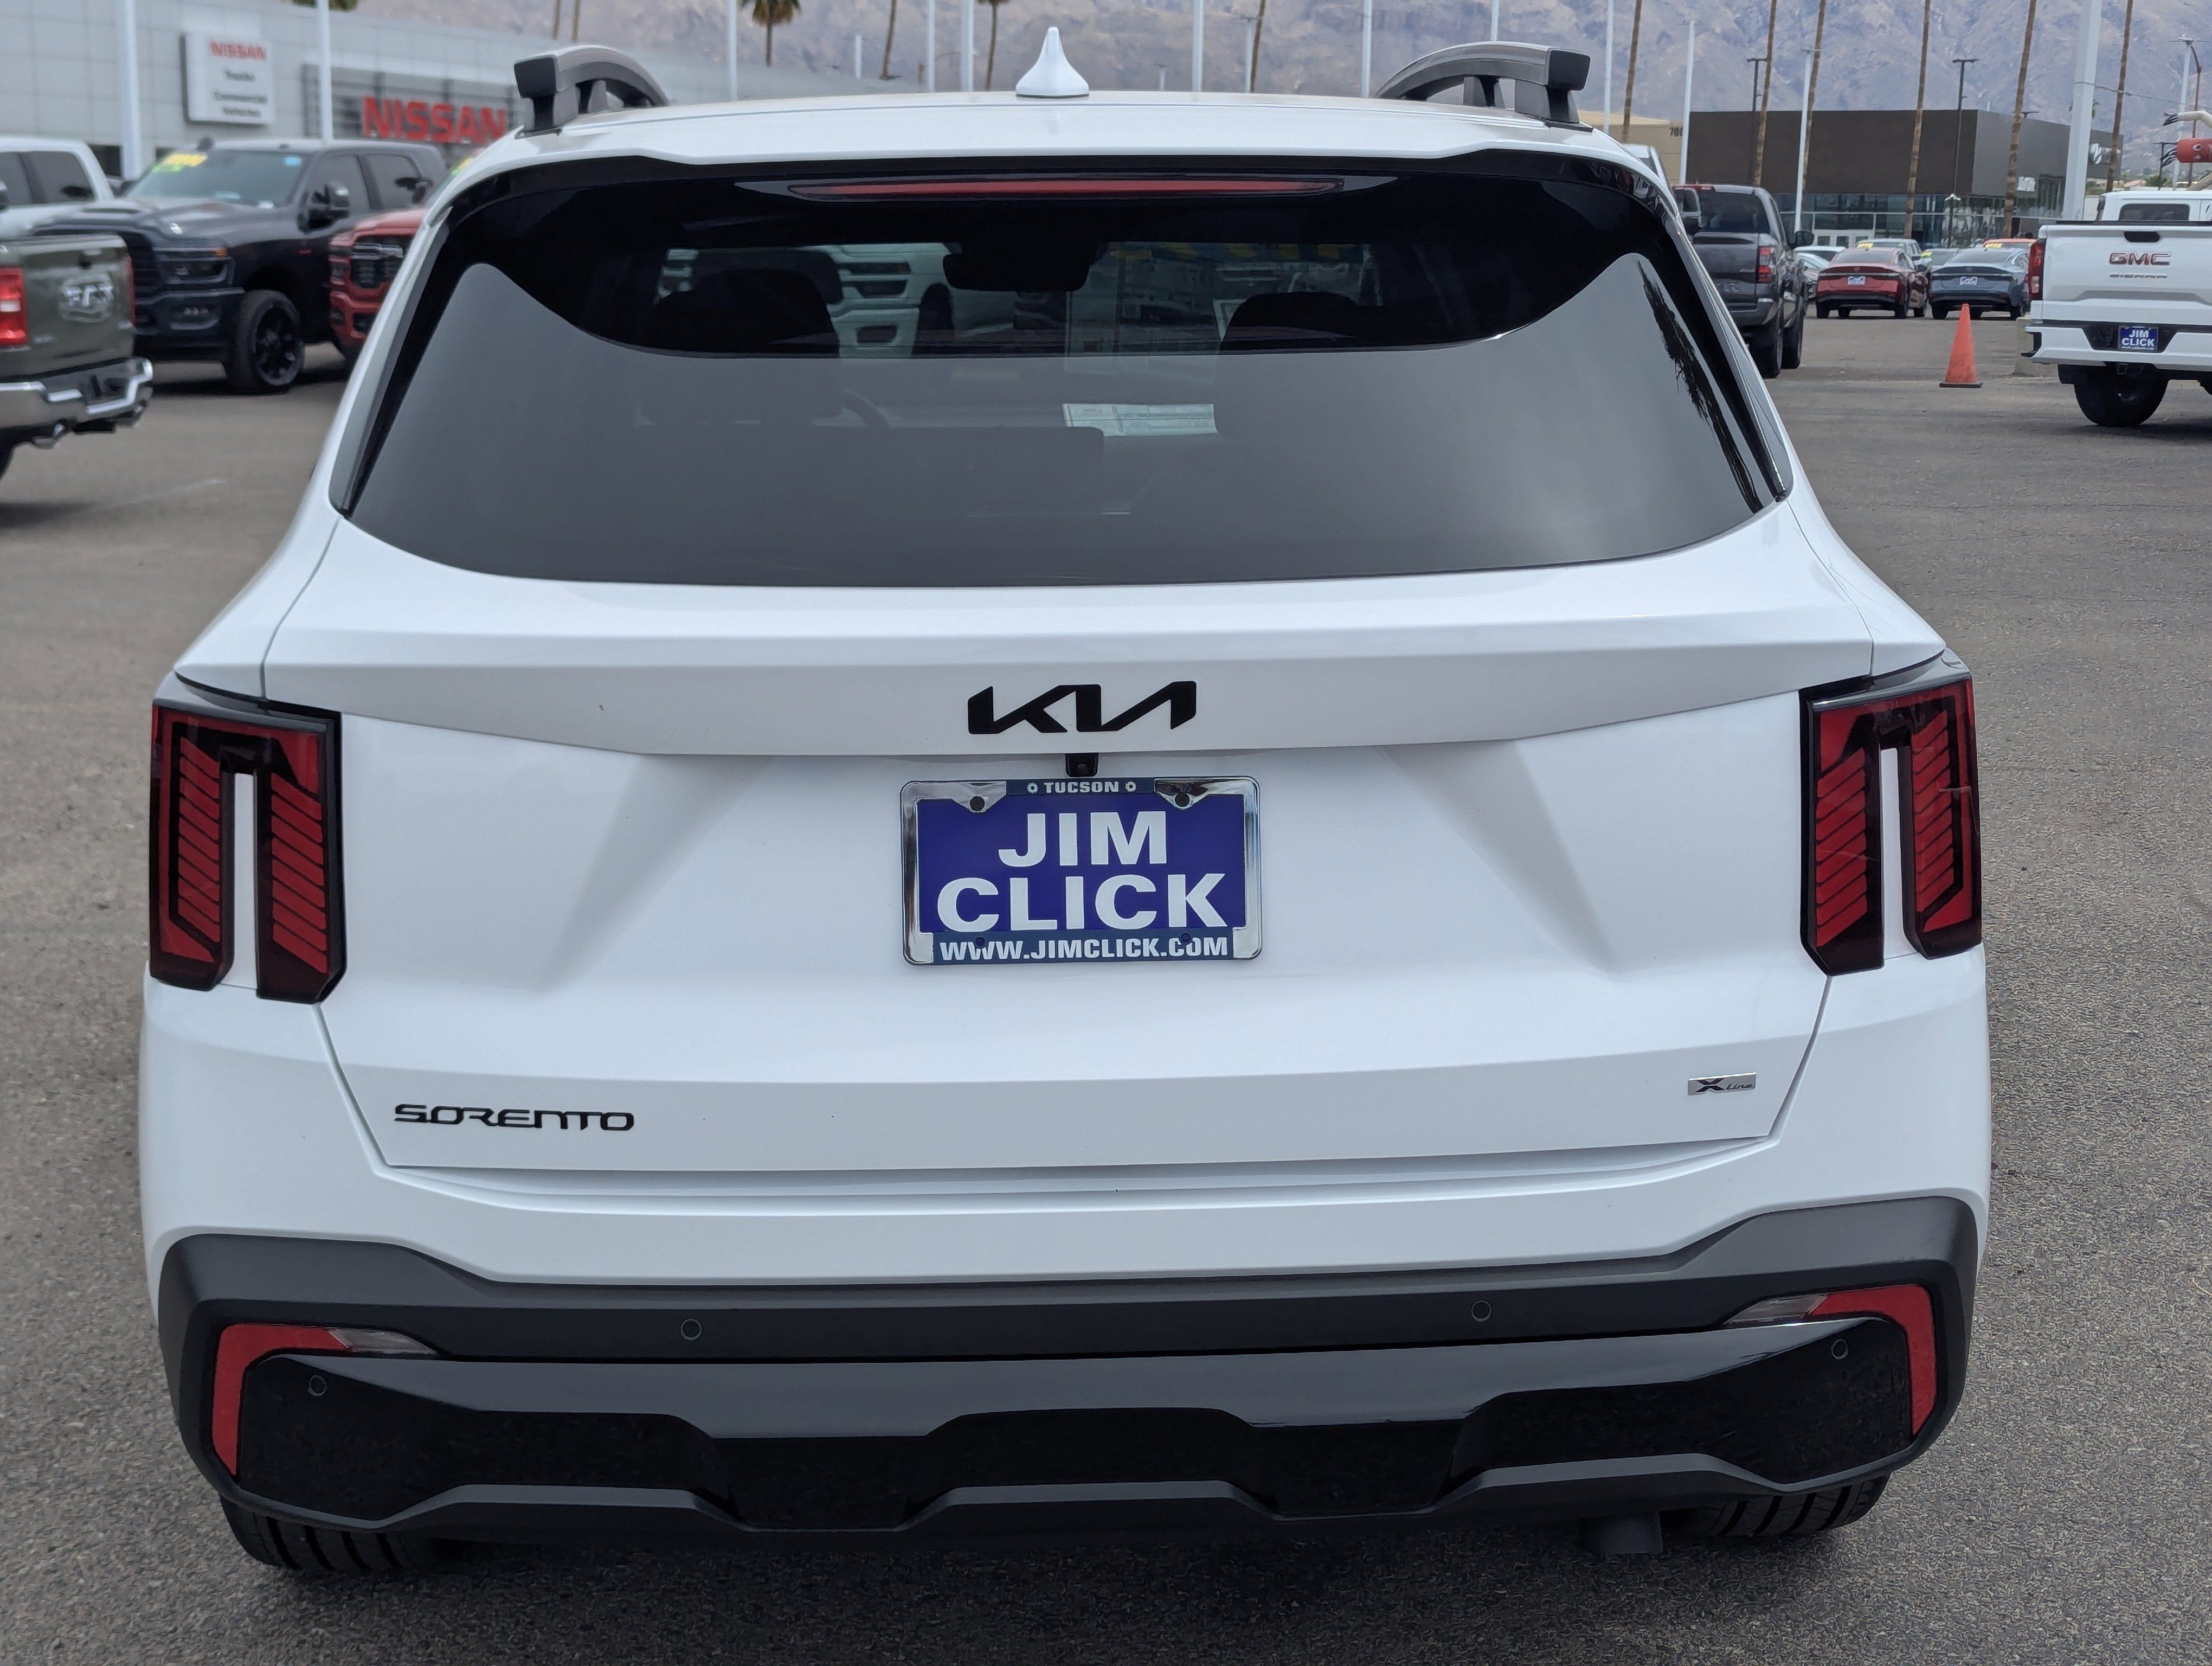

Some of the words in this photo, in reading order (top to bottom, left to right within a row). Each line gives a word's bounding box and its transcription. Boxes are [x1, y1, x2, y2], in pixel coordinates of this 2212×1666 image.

[210, 41, 267, 60] NISSAN
[363, 96, 506, 145] NISSAN
[2109, 252, 2171, 266] GMC
[2121, 338, 2155, 347] CLICK
[2129, 329, 2149, 338] JIM
[968, 681, 1197, 734] KIA
[1044, 781, 1119, 793] TUCSON
[998, 811, 1167, 867] JIM
[937, 873, 1227, 932] CLICK
[940, 937, 1227, 961] WWW.JIMCLICK.COM
[394, 1104, 634, 1131] SORENTO
